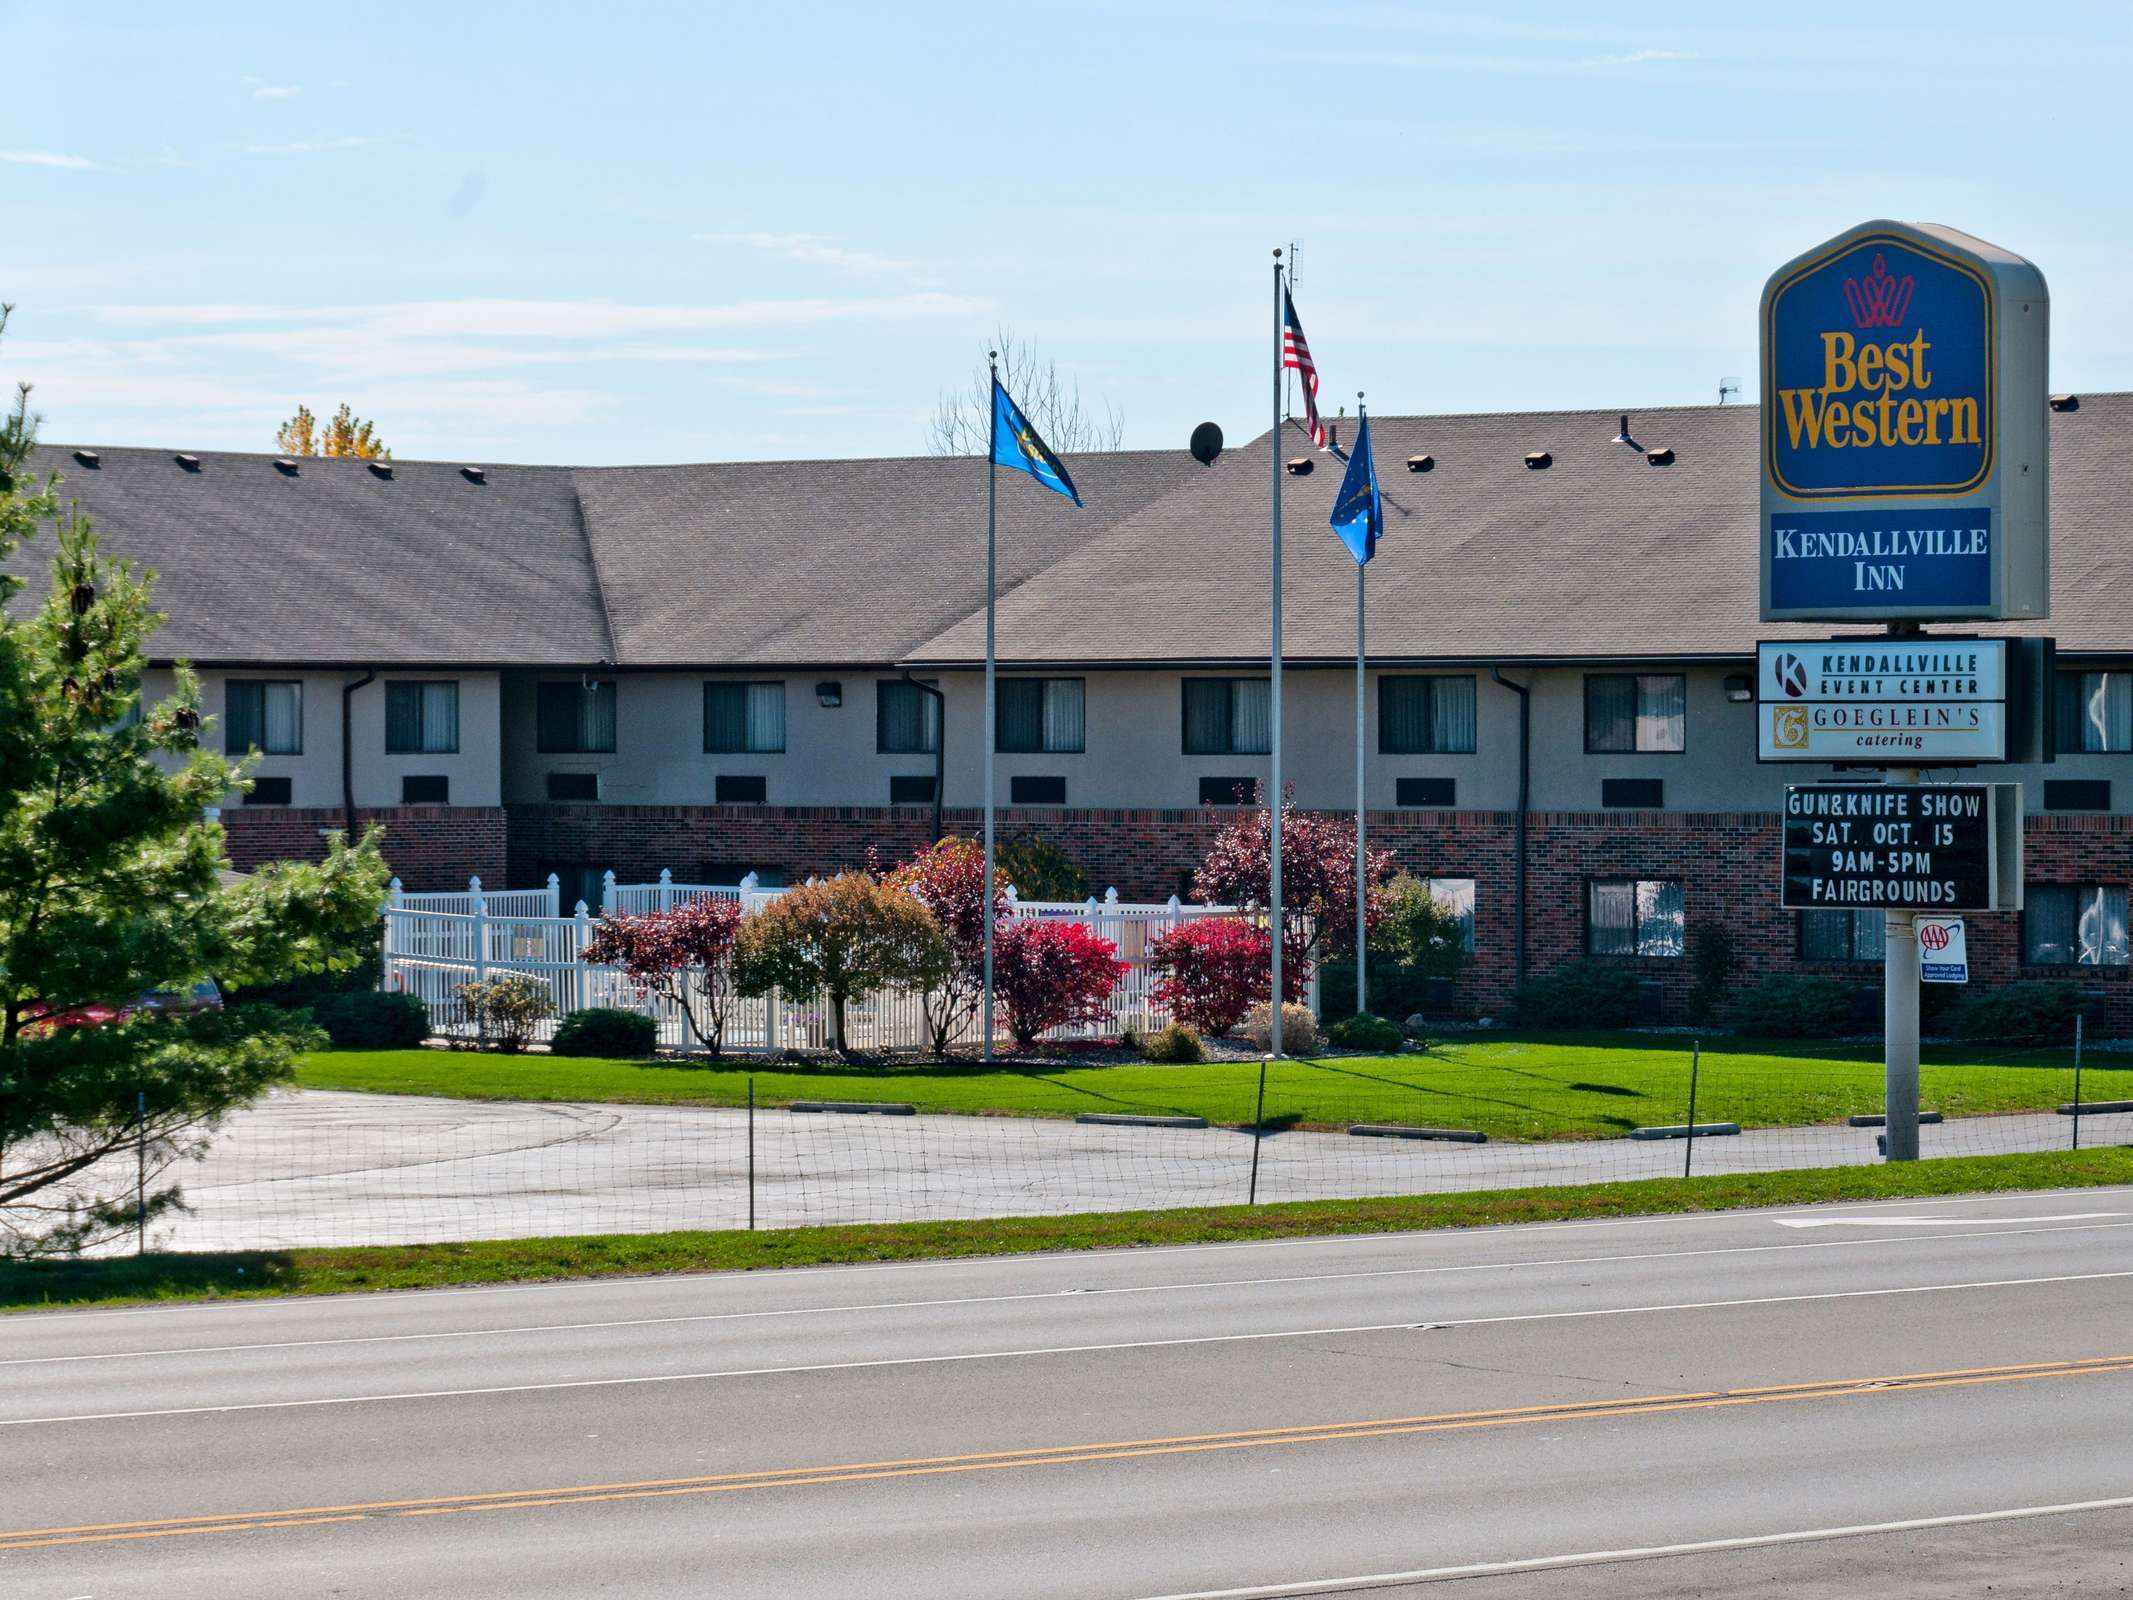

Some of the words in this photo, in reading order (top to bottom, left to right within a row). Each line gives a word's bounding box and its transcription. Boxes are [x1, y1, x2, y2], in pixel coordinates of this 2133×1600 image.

[1820, 327, 1932, 394] Best
[1778, 374, 1982, 450] Western
[1774, 528, 1988, 559] KENDALLVILLE
[1853, 562, 1905, 591] INN
[1822, 654, 1977, 672] KENDALLVILLE
[1820, 680, 1883, 694] EVENT
[1900, 680, 1978, 694] CENTER
[1814, 708, 1979, 726] GOEGLEIN'S
[1856, 733, 1923, 750] catering
[1788, 793, 1908, 816] GUN&KNIFE
[1921, 795, 1981, 817] SHOW
[1812, 822, 1859, 845] SAT.
[1873, 823, 1919, 846] OCT.
[1934, 824, 1954, 846] 15
[1832, 850, 1932, 875] 9AM-5PM
[1812, 879, 1956, 903] FAIRGROUNDS
